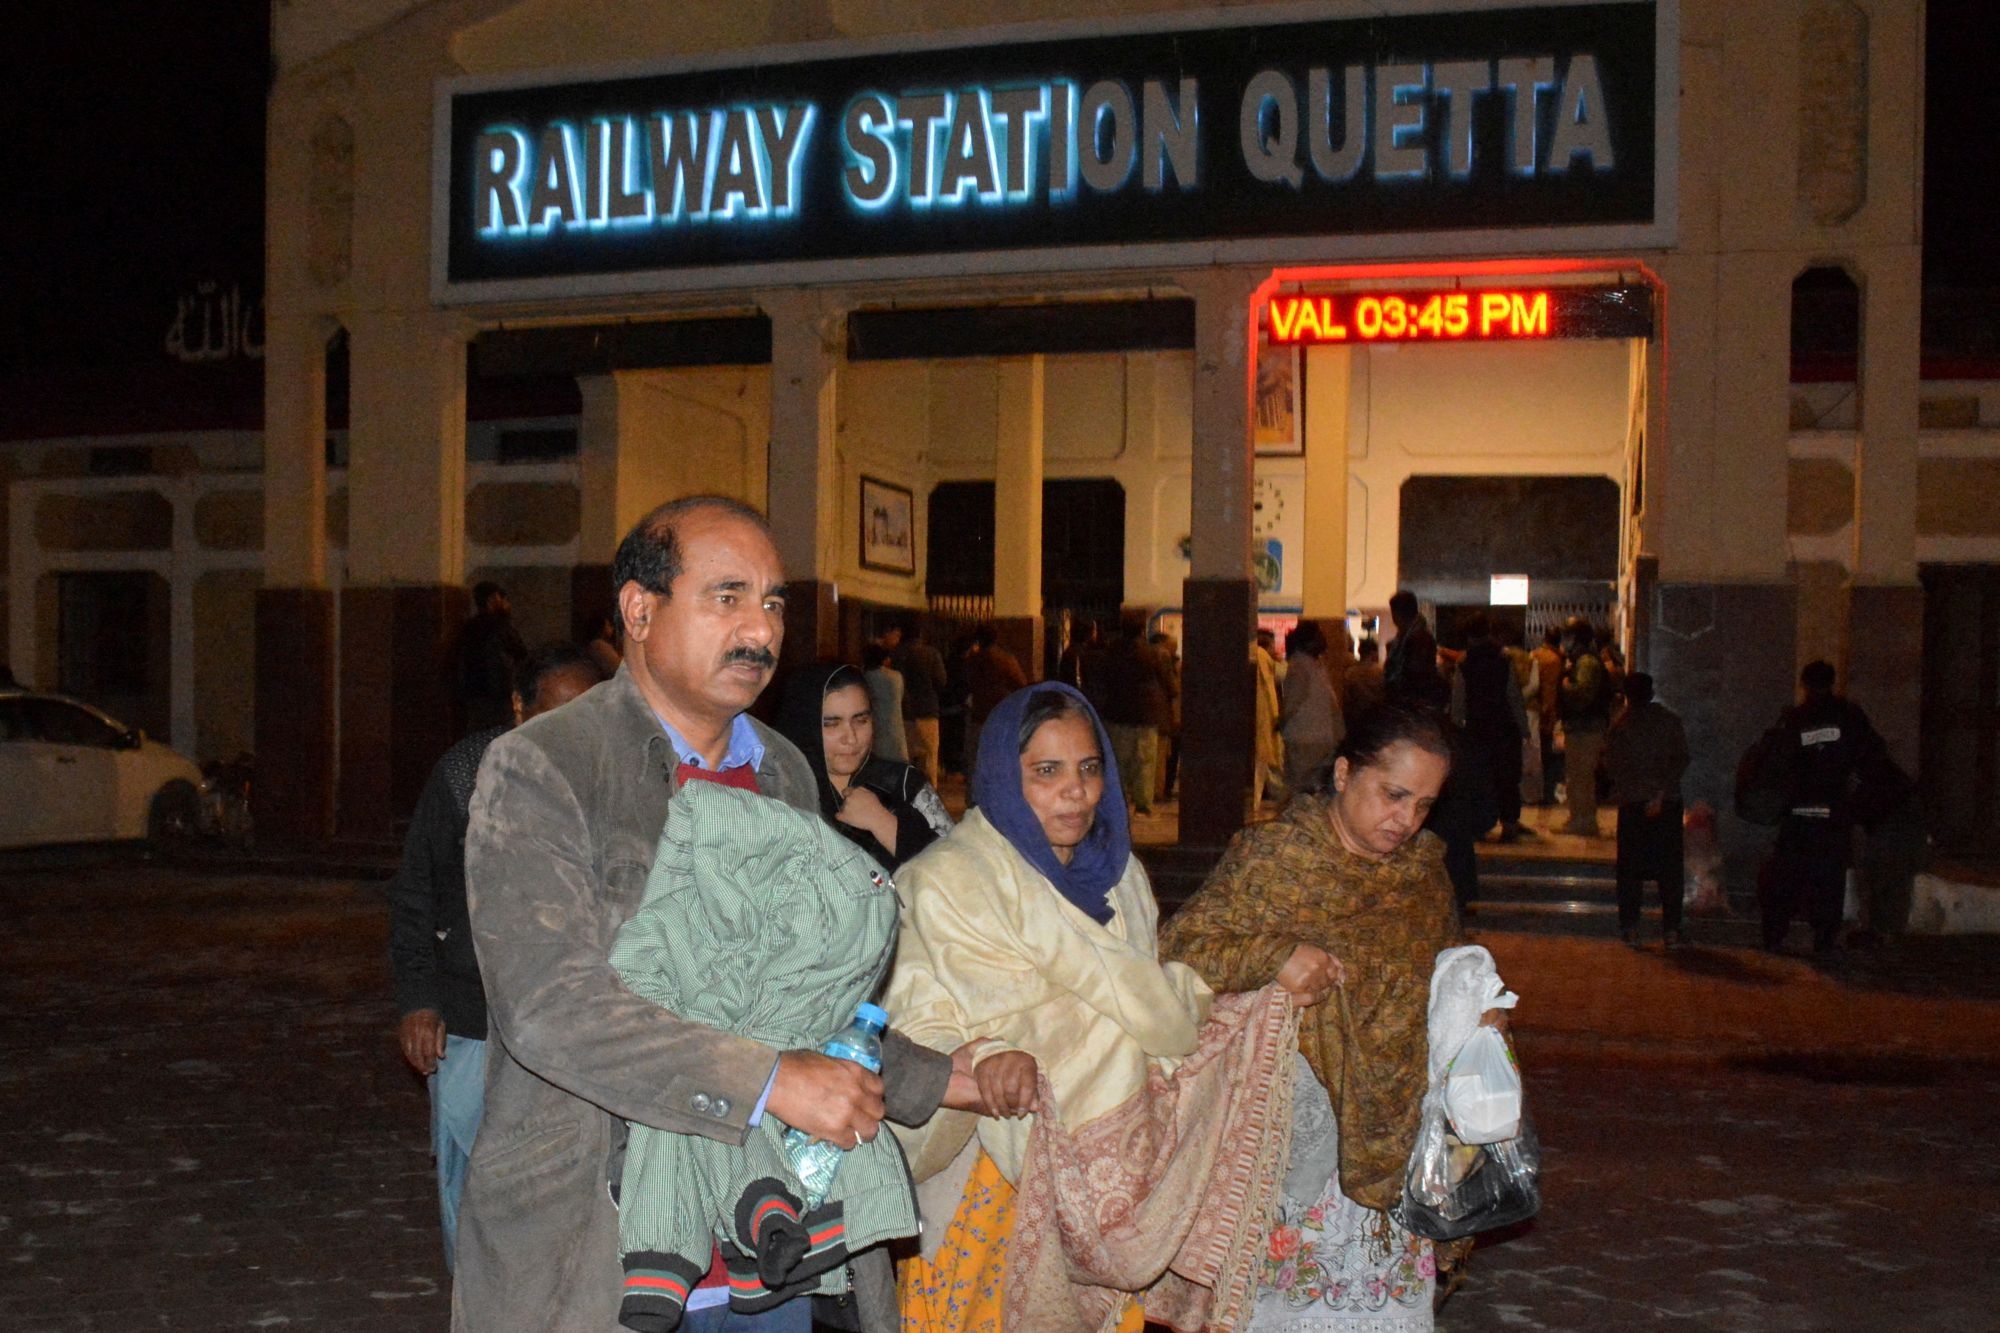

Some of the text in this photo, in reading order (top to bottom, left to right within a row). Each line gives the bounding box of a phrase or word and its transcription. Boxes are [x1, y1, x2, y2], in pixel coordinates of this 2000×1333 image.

[476, 54, 1614, 238] RAILWAY STATION QUETTA
[1270, 292, 1548, 341] VAL 03:45 PM
